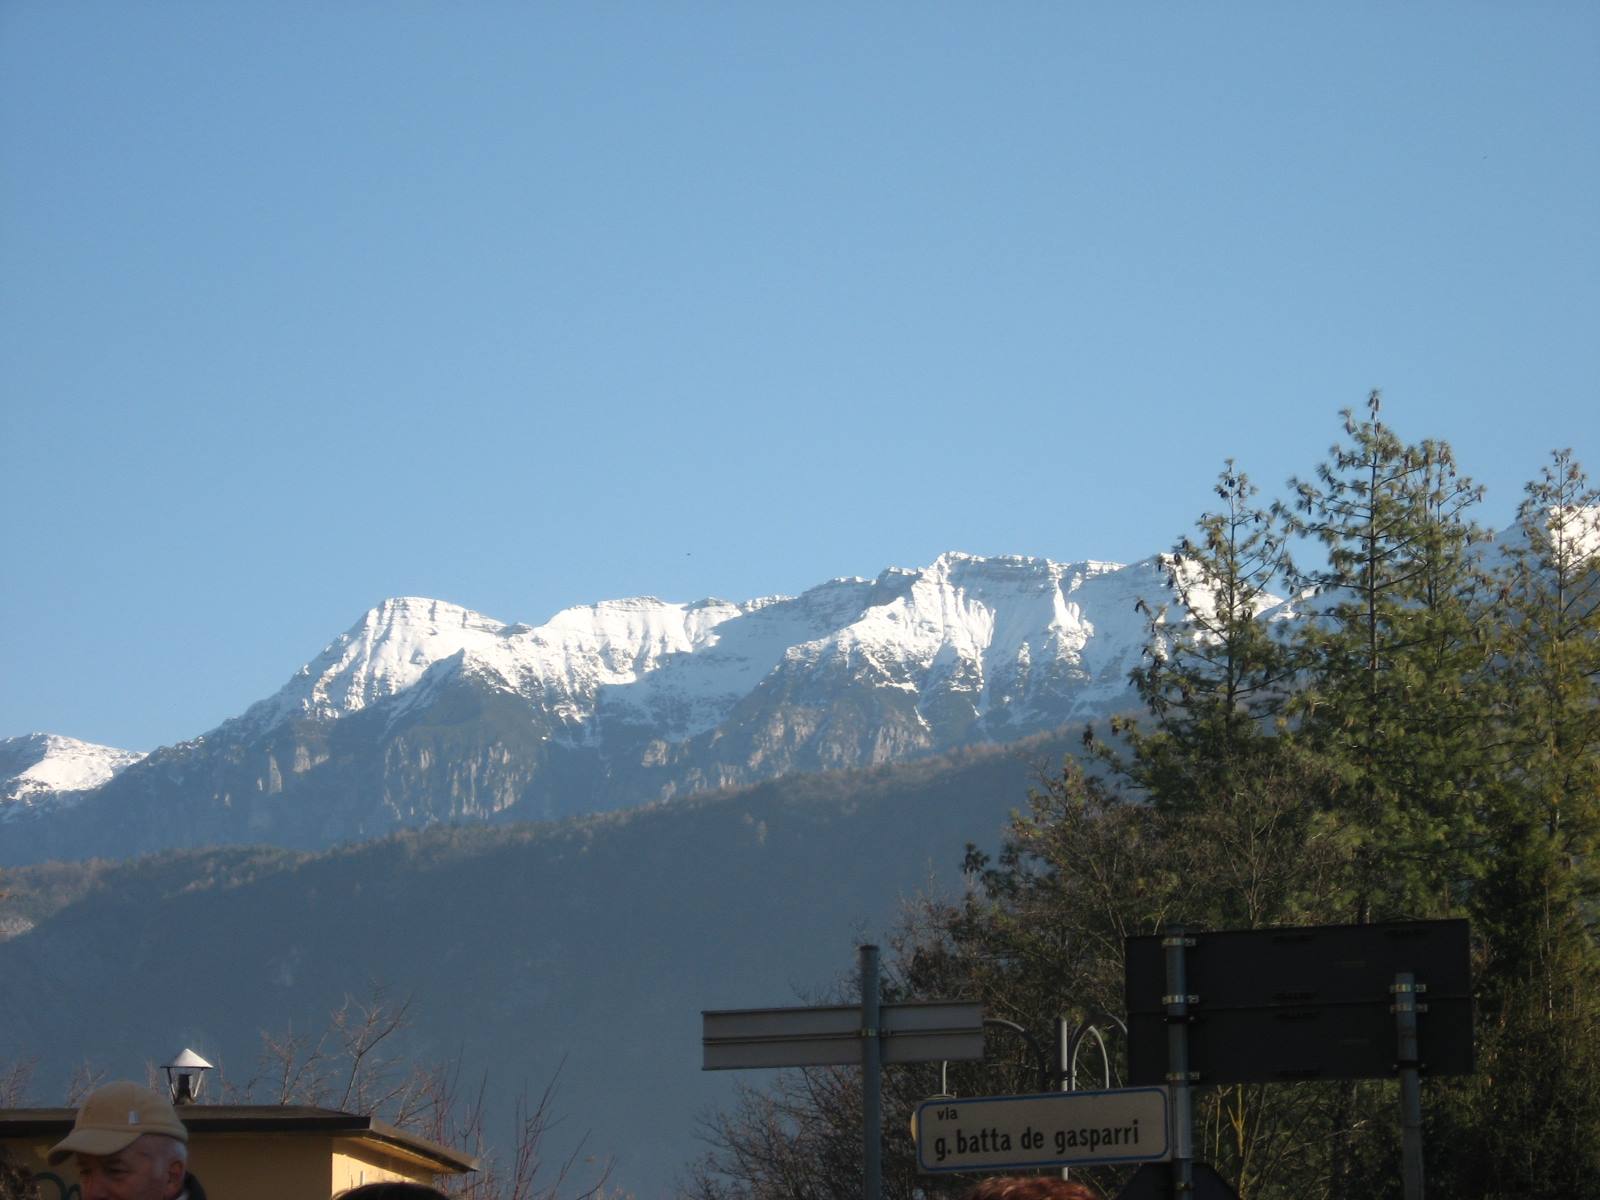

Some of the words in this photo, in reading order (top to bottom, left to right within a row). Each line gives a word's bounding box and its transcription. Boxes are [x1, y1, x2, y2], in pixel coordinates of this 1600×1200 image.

[937, 1107, 958, 1120] via
[1021, 1126, 1044, 1149] de
[1054, 1119, 1139, 1154] gasparri
